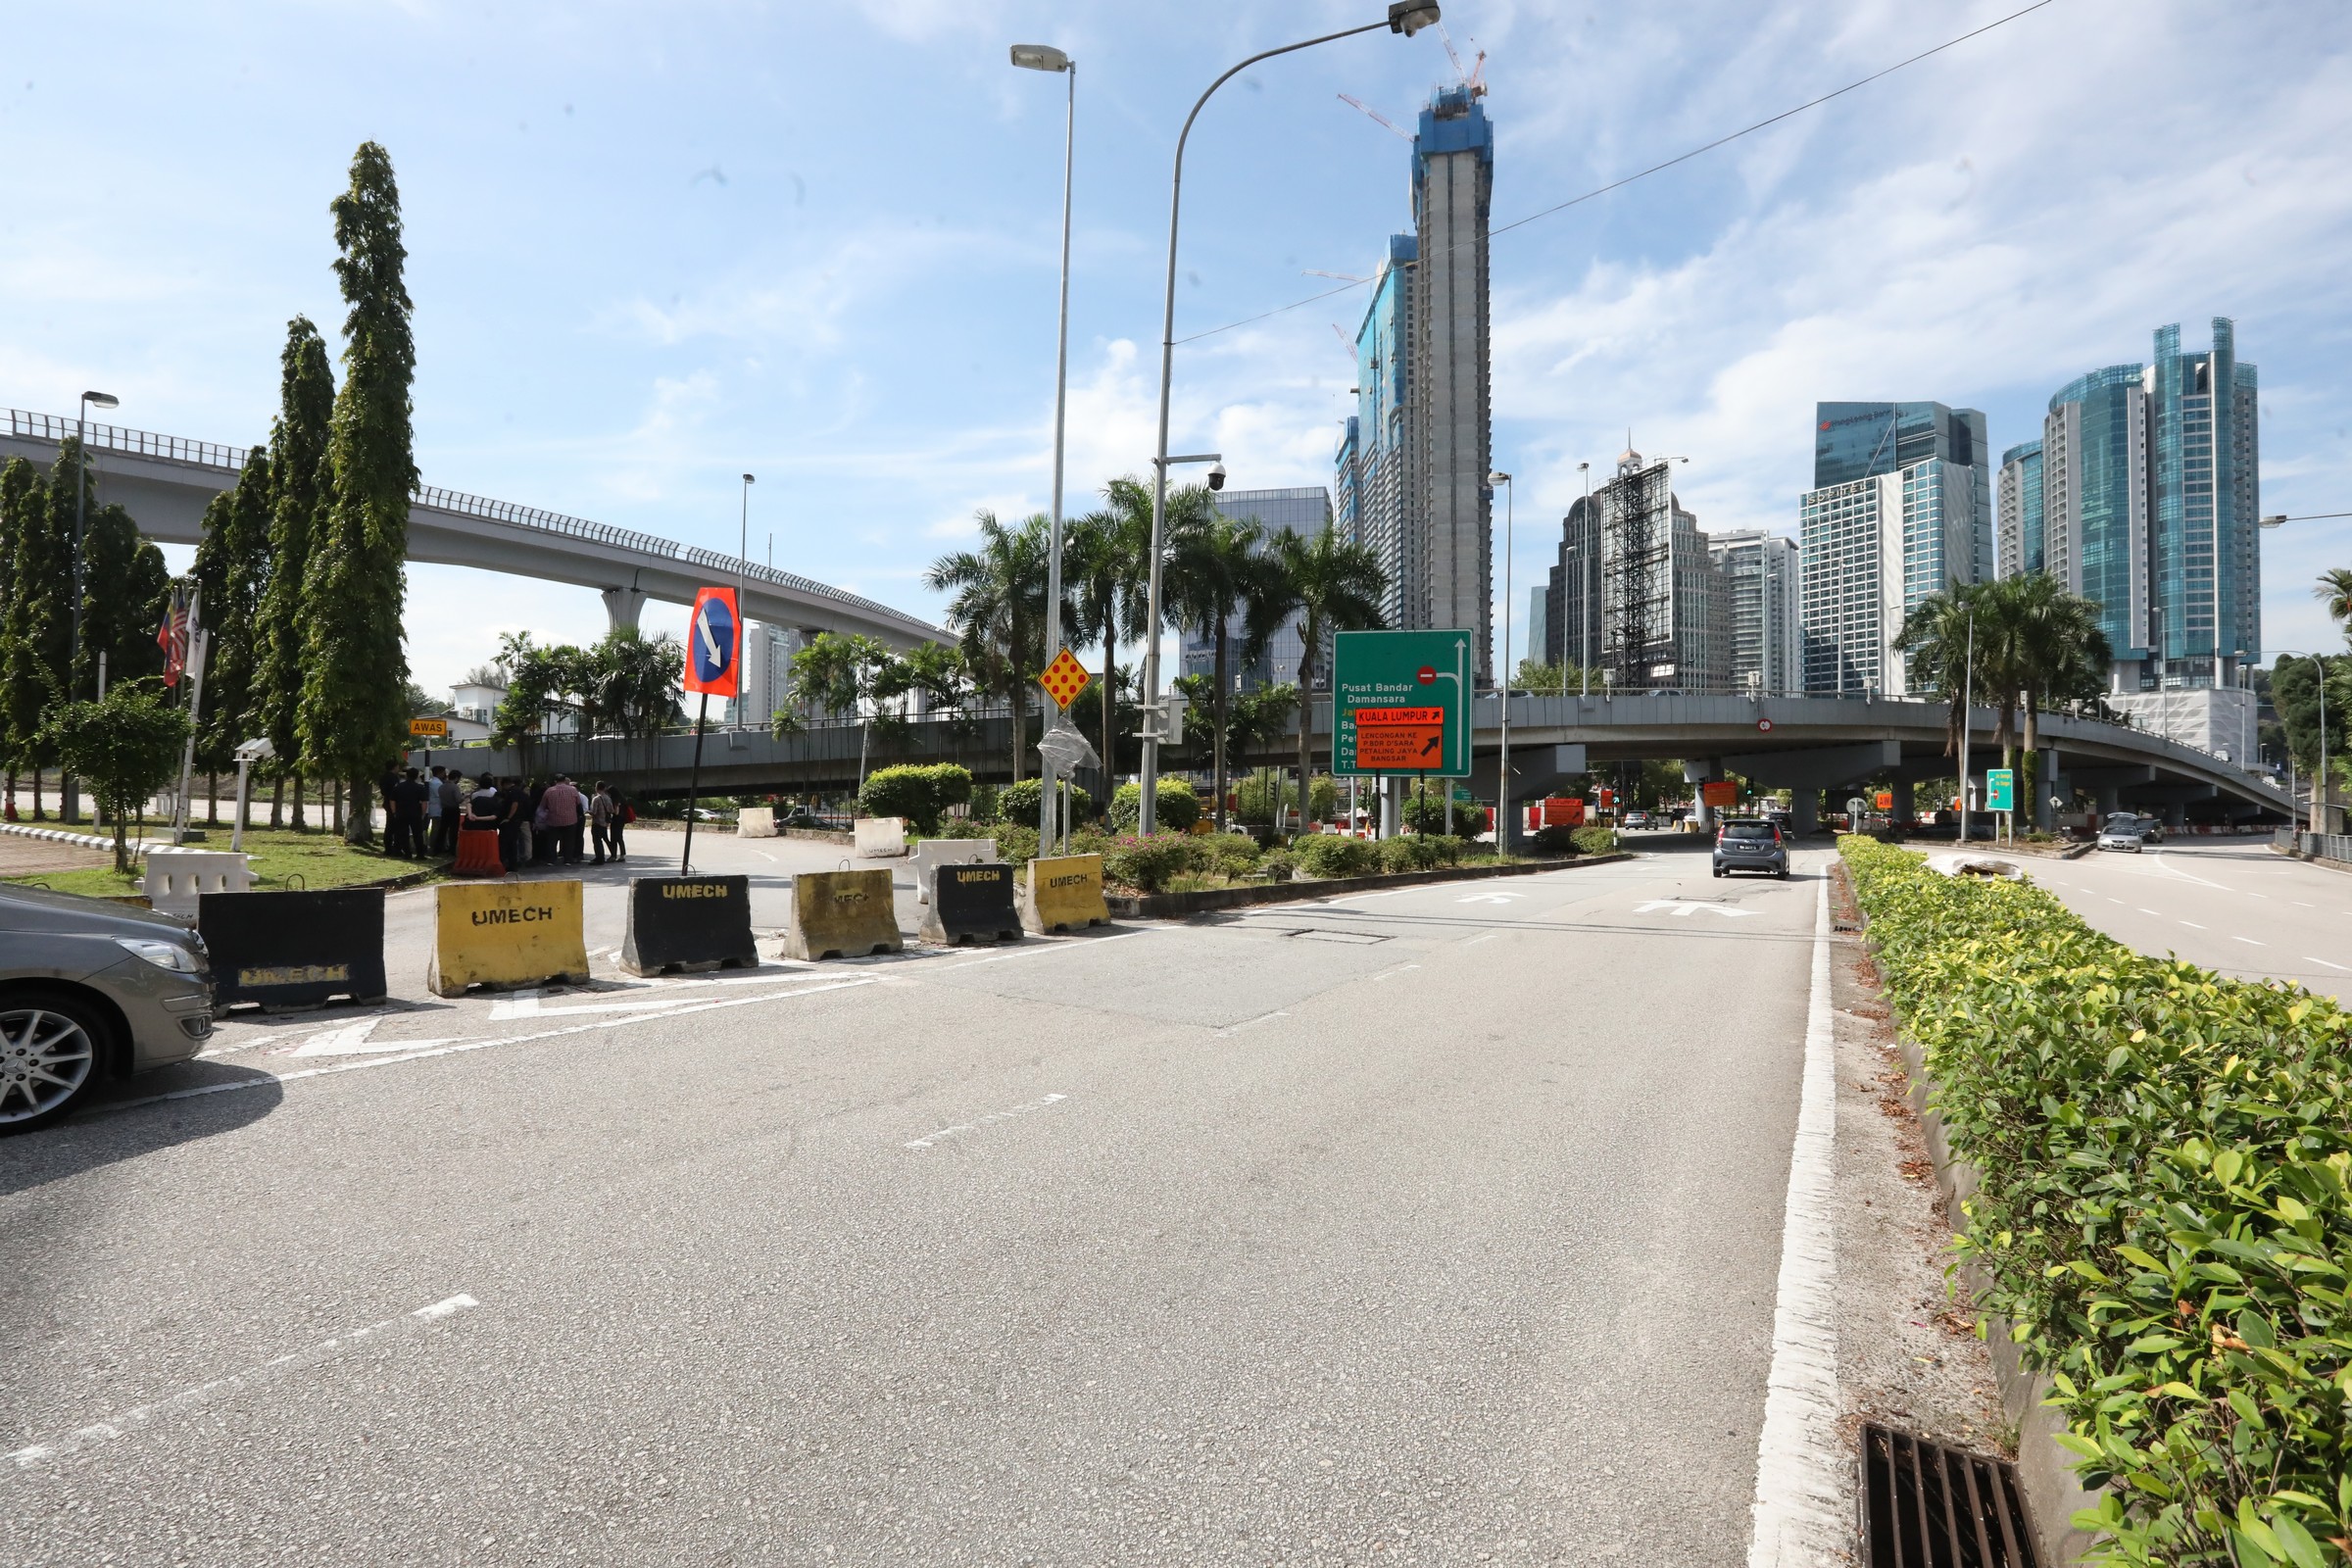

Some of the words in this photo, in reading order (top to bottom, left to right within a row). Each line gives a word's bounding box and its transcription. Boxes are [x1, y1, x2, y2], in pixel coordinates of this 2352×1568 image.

[1342, 683, 1371, 692] Pusat
[1376, 683, 1413, 692] Bandar
[1348, 695, 1405, 704] Damansara
[1359, 711, 1388, 721] KUALA
[1391, 710, 1428, 721] LUMPUR
[414, 722, 442, 732] AWAS
[956, 870, 1001, 882] UMECH
[1050, 874, 1088, 888] UMECH
[662, 884, 728, 899] UMECH
[471, 906, 553, 926] UMECH
